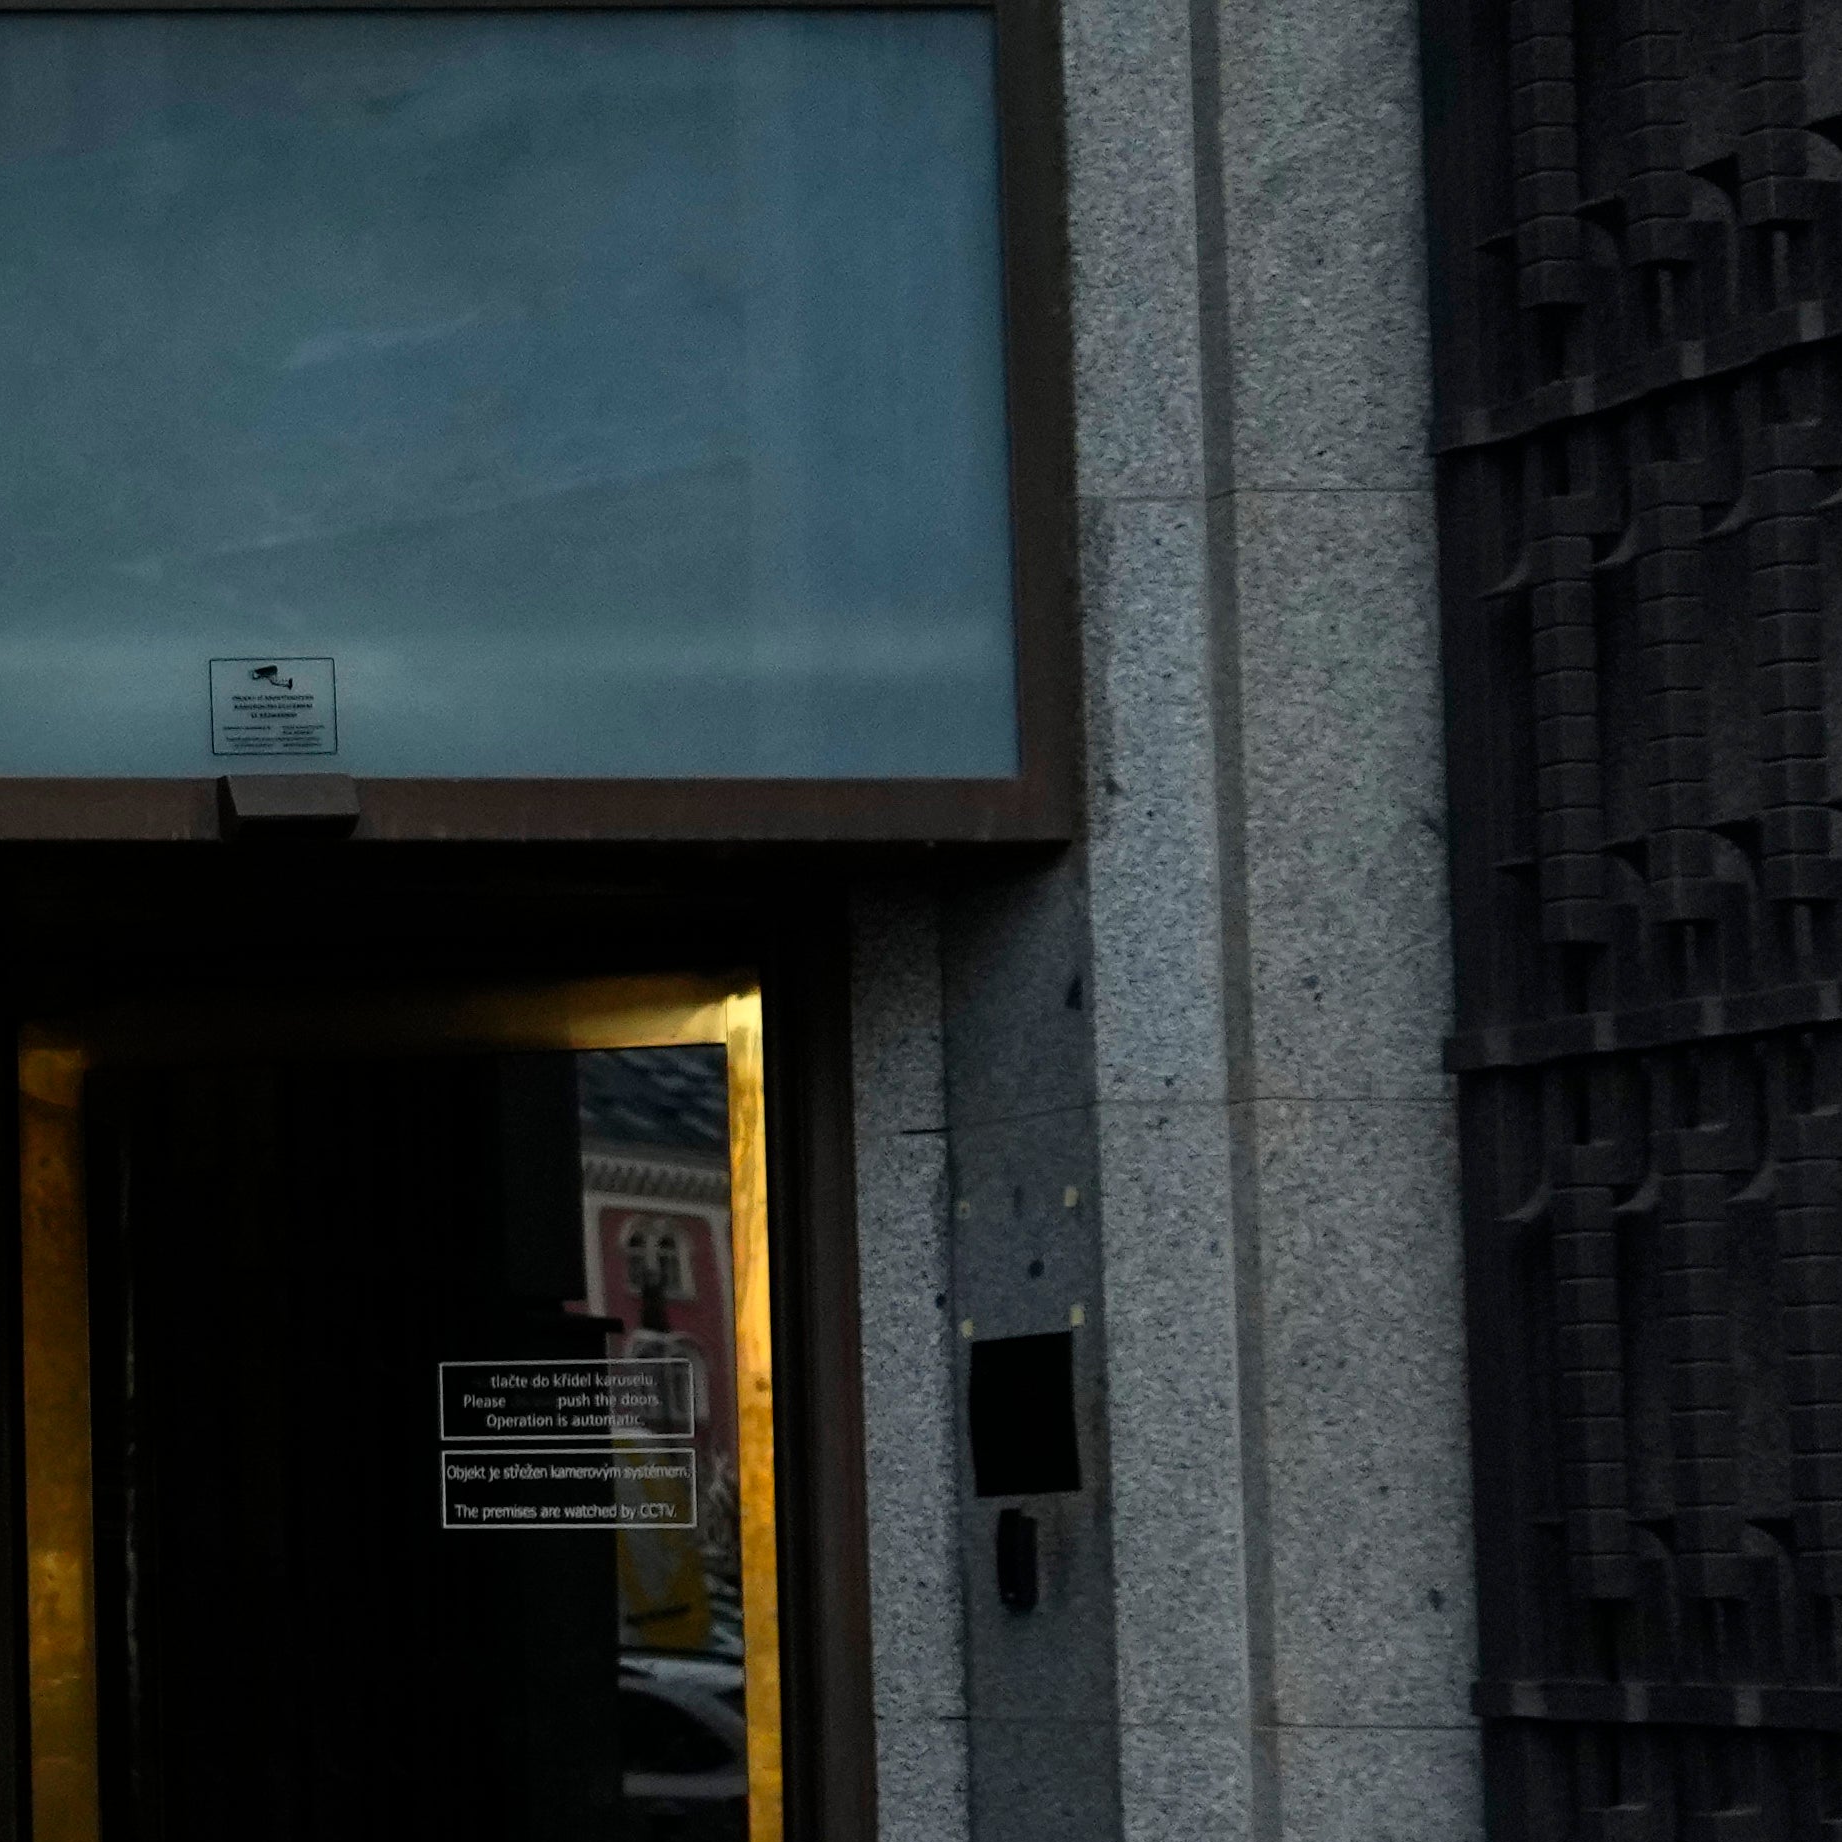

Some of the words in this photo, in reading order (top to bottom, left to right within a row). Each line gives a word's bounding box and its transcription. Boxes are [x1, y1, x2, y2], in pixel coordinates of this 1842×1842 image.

[491, 1374, 528, 1388] tlačte
[532, 1373, 550, 1388] do
[463, 1393, 506, 1408] Please
[558, 1393, 590, 1410] push
[594, 1393, 617, 1408] the
[486, 1413, 553, 1430] Operation
[558, 1413, 568, 1427] is
[447, 1465, 486, 1482] Objekt
[488, 1465, 501, 1482] je
[550, 1463, 621, 1481] kamerovým
[454, 1504, 479, 1518] The
[482, 1504, 537, 1521] premises
[540, 1506, 561, 1518] are
[564, 1504, 617, 1519] watched
[620, 1504, 637, 1520] by
